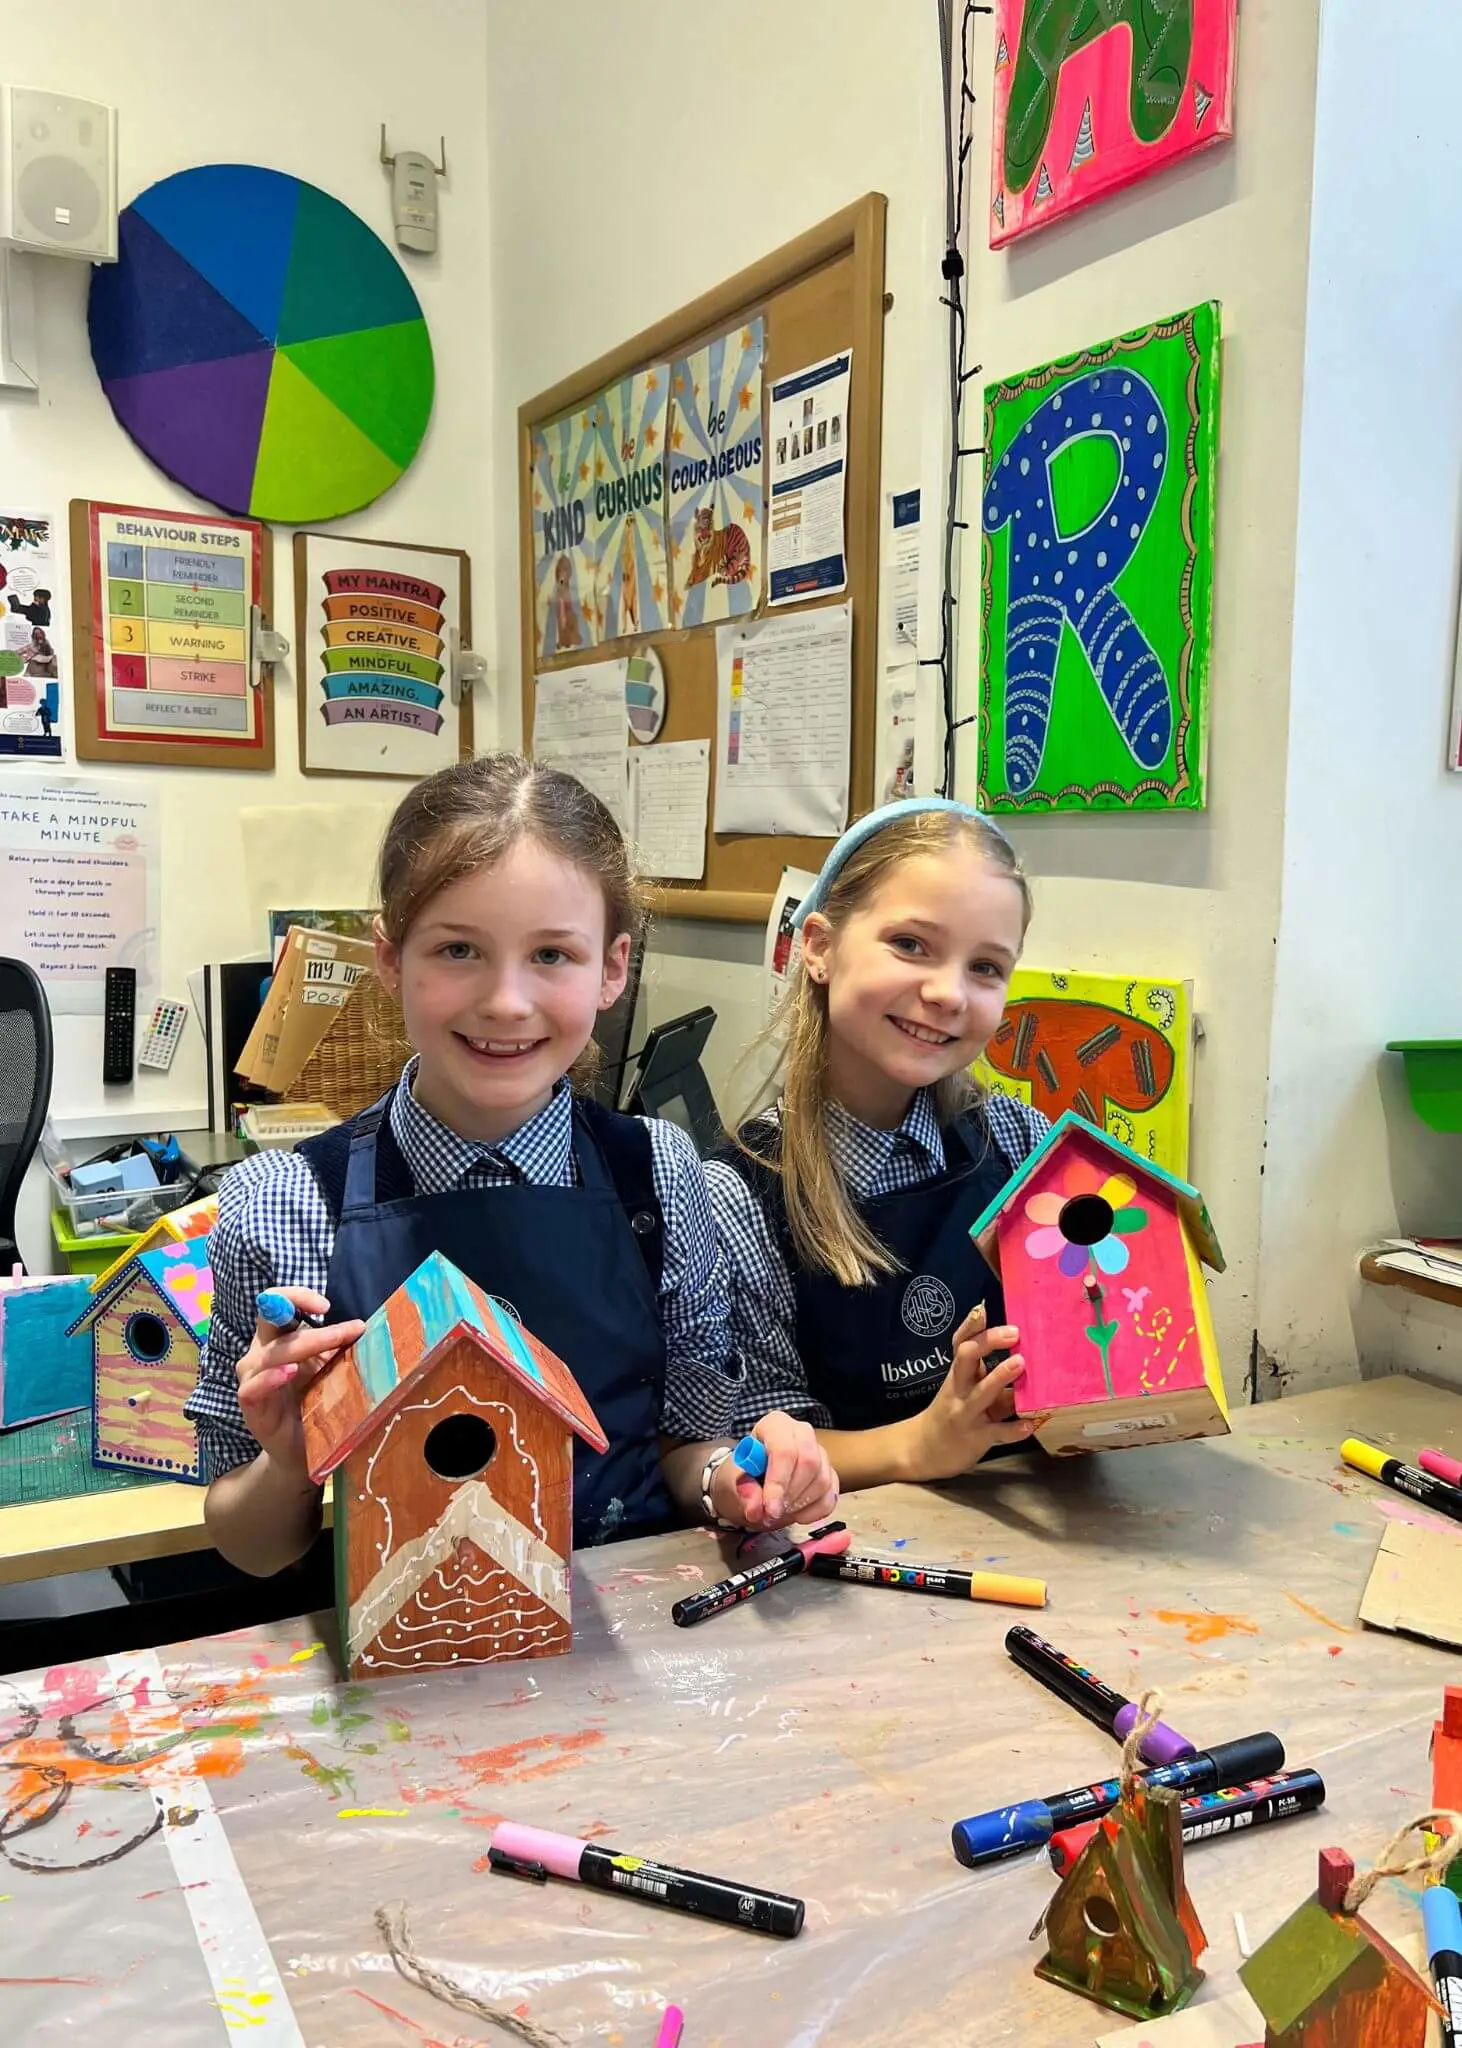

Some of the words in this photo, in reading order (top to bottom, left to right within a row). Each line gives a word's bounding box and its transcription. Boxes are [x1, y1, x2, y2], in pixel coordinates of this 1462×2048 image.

[707, 400, 726, 438] be
[621, 430, 635, 462] be
[671, 437, 761, 494] COURAGEOUS
[596, 462, 662, 522] CURIOUS
[116, 522, 197, 543] BEHAVIOUR
[200, 533, 241, 548] STEPS
[543, 499, 586, 554] KIND
[174, 556, 217, 569] FRIENDLY
[172, 570, 219, 582] REMINDER
[338, 575, 360, 588] MY
[366, 575, 431, 600] MANTRA
[122, 589, 133, 606] 2
[176, 594, 215, 607] SECOND
[174, 608, 220, 619] REMINDER
[349, 605, 419, 624] POSITIVE.
[122, 625, 134, 642] 3
[346, 630, 421, 650] CREATIVE.
[169, 637, 226, 650] WARNING
[349, 657, 418, 675] MINDFUL.
[180, 670, 217, 683] STRIKE
[348, 682, 420, 700] AMAZING.
[145, 703, 181, 714] REFLECT
[184, 706, 192, 715] &
[193, 705, 218, 716] RESET
[344, 708, 365, 720] AN
[370, 709, 422, 727] ARTIST.
[1, 811, 40, 823] TAKE
[50, 814, 59, 824] A
[68, 815, 137, 828] MINDFUL
[41, 830, 101, 843] MINUTE
[307, 961, 334, 981] my
[881, 1346, 951, 1382] Ibstock
[925, 1575, 947, 1586] uni
[1069, 1790, 1094, 1805] uni
